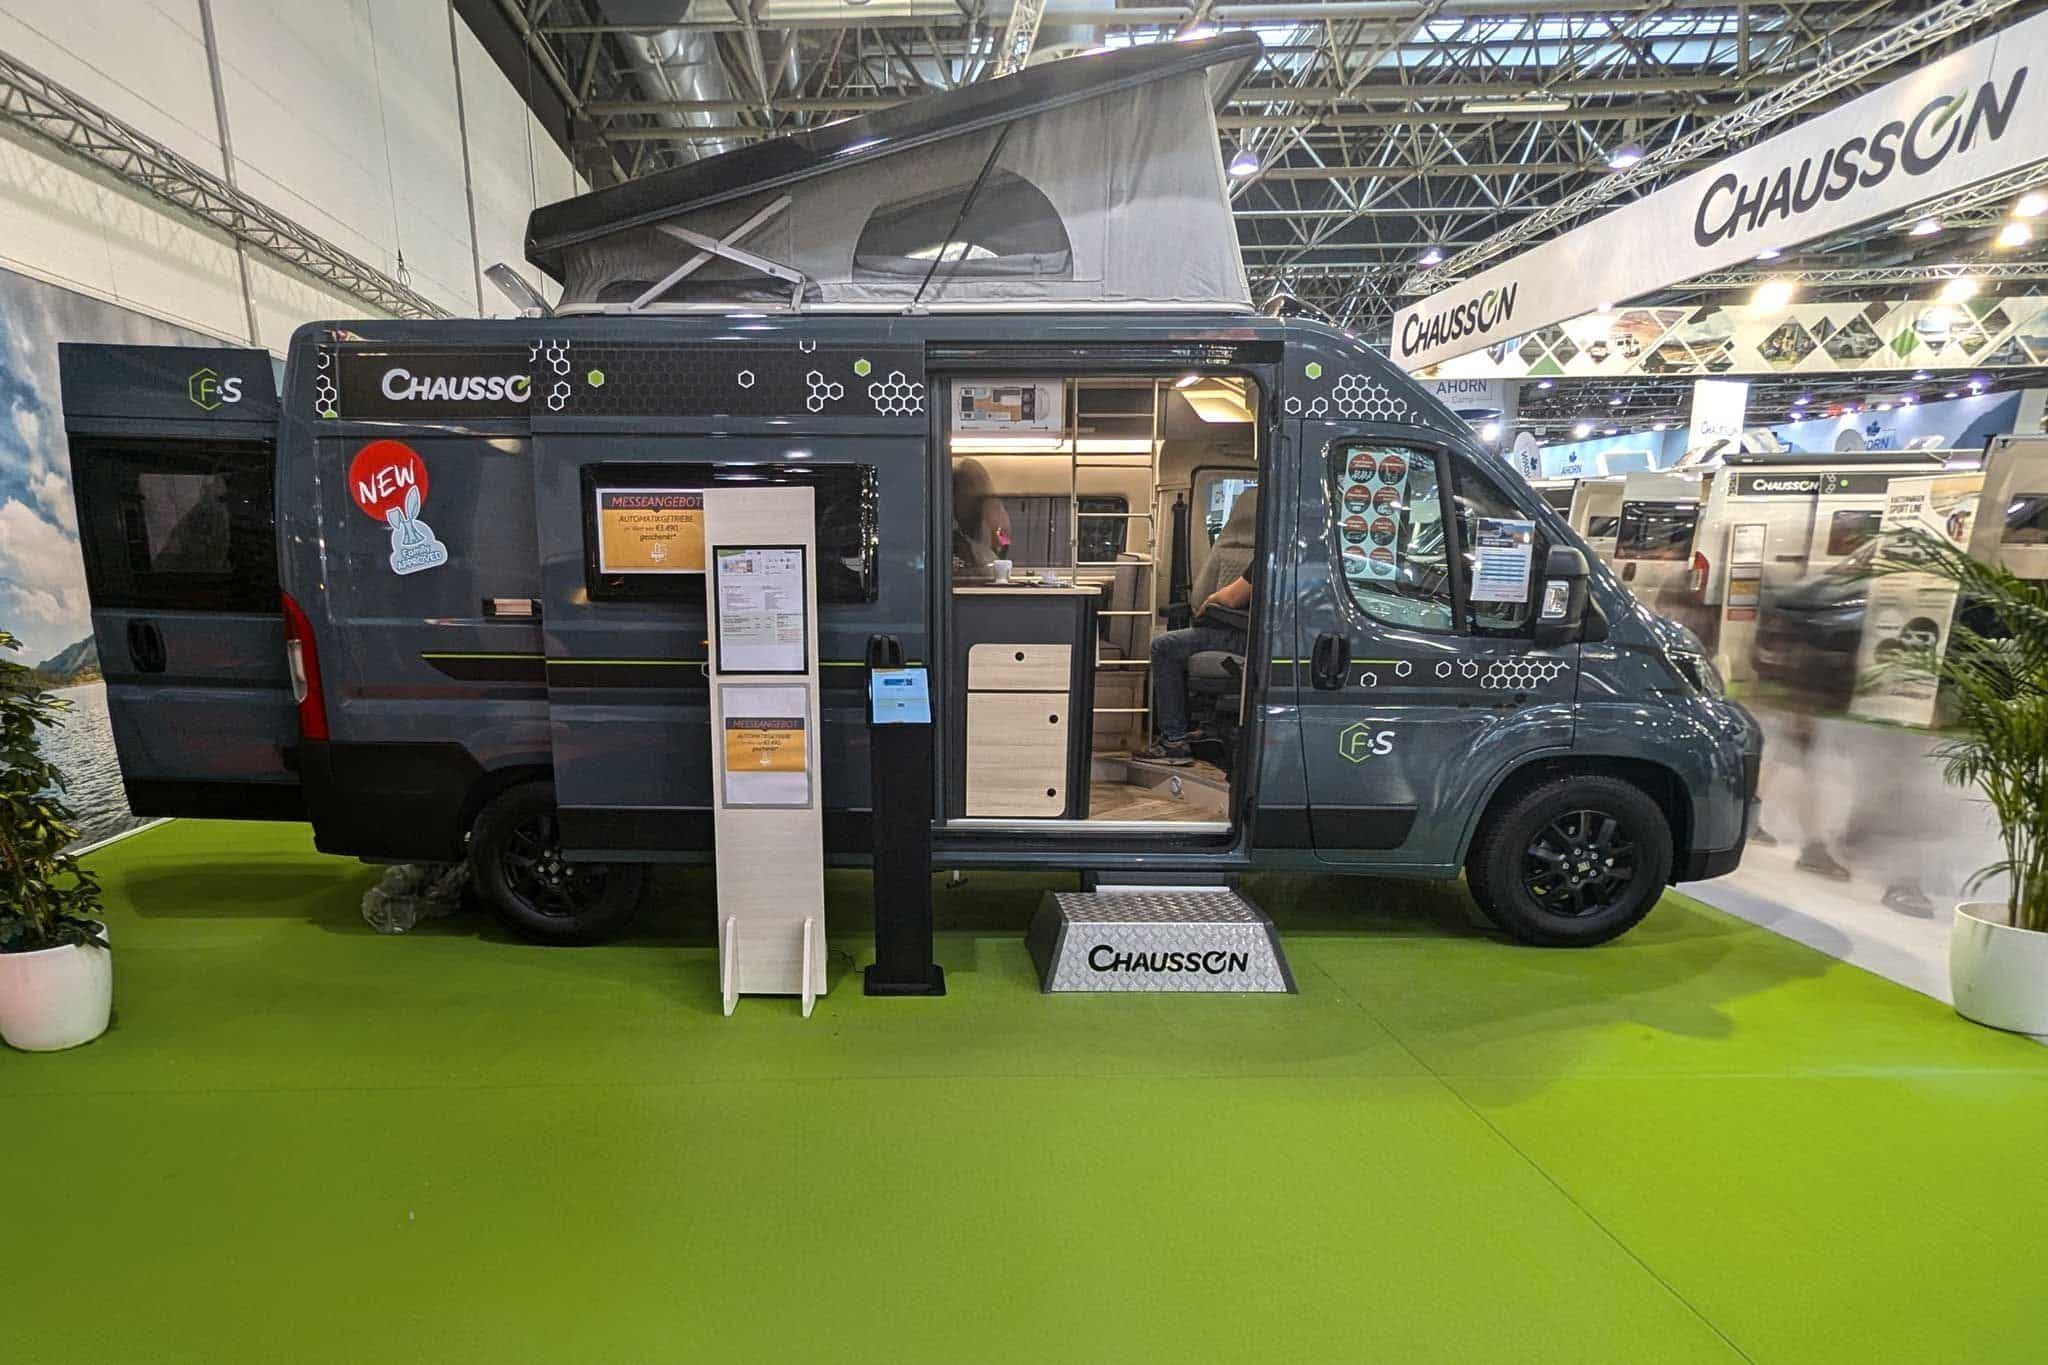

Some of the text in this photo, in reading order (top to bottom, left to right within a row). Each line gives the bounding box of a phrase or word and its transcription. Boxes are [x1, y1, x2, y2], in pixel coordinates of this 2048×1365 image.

[1694, 66, 2029, 247] CHAUSSON
[1402, 282, 1517, 357] CHAUSSON
[382, 368, 531, 403] CHAUSSO
[1437, 379, 1487, 394] AHORN
[1864, 437, 1888, 449] ORN
[359, 458, 415, 504] NEW
[1753, 479, 1819, 491] CHAUSSON
[1088, 944, 1248, 974] CHAUSSON
